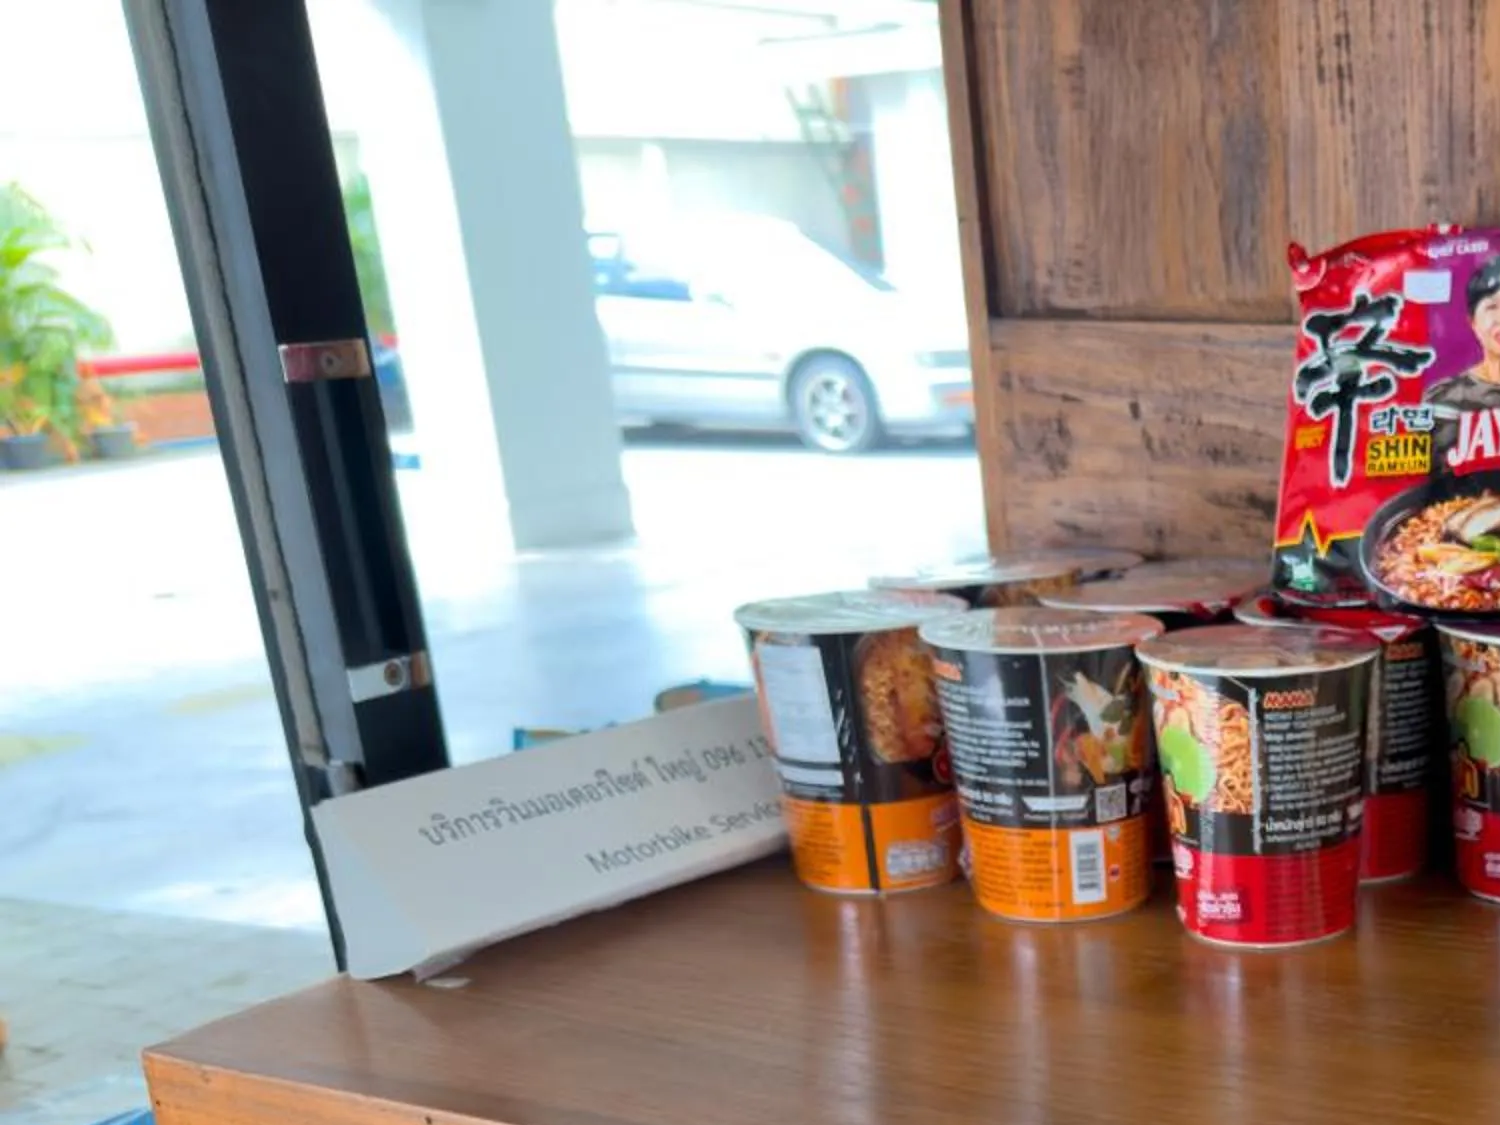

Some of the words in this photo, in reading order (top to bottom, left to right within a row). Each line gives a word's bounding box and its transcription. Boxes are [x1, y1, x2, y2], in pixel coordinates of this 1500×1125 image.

[1371, 405, 1434, 434] 라면
[1369, 438, 1428, 460] SHIN
[702, 744, 746, 771] 096
[585, 824, 714, 875] Motorbike
